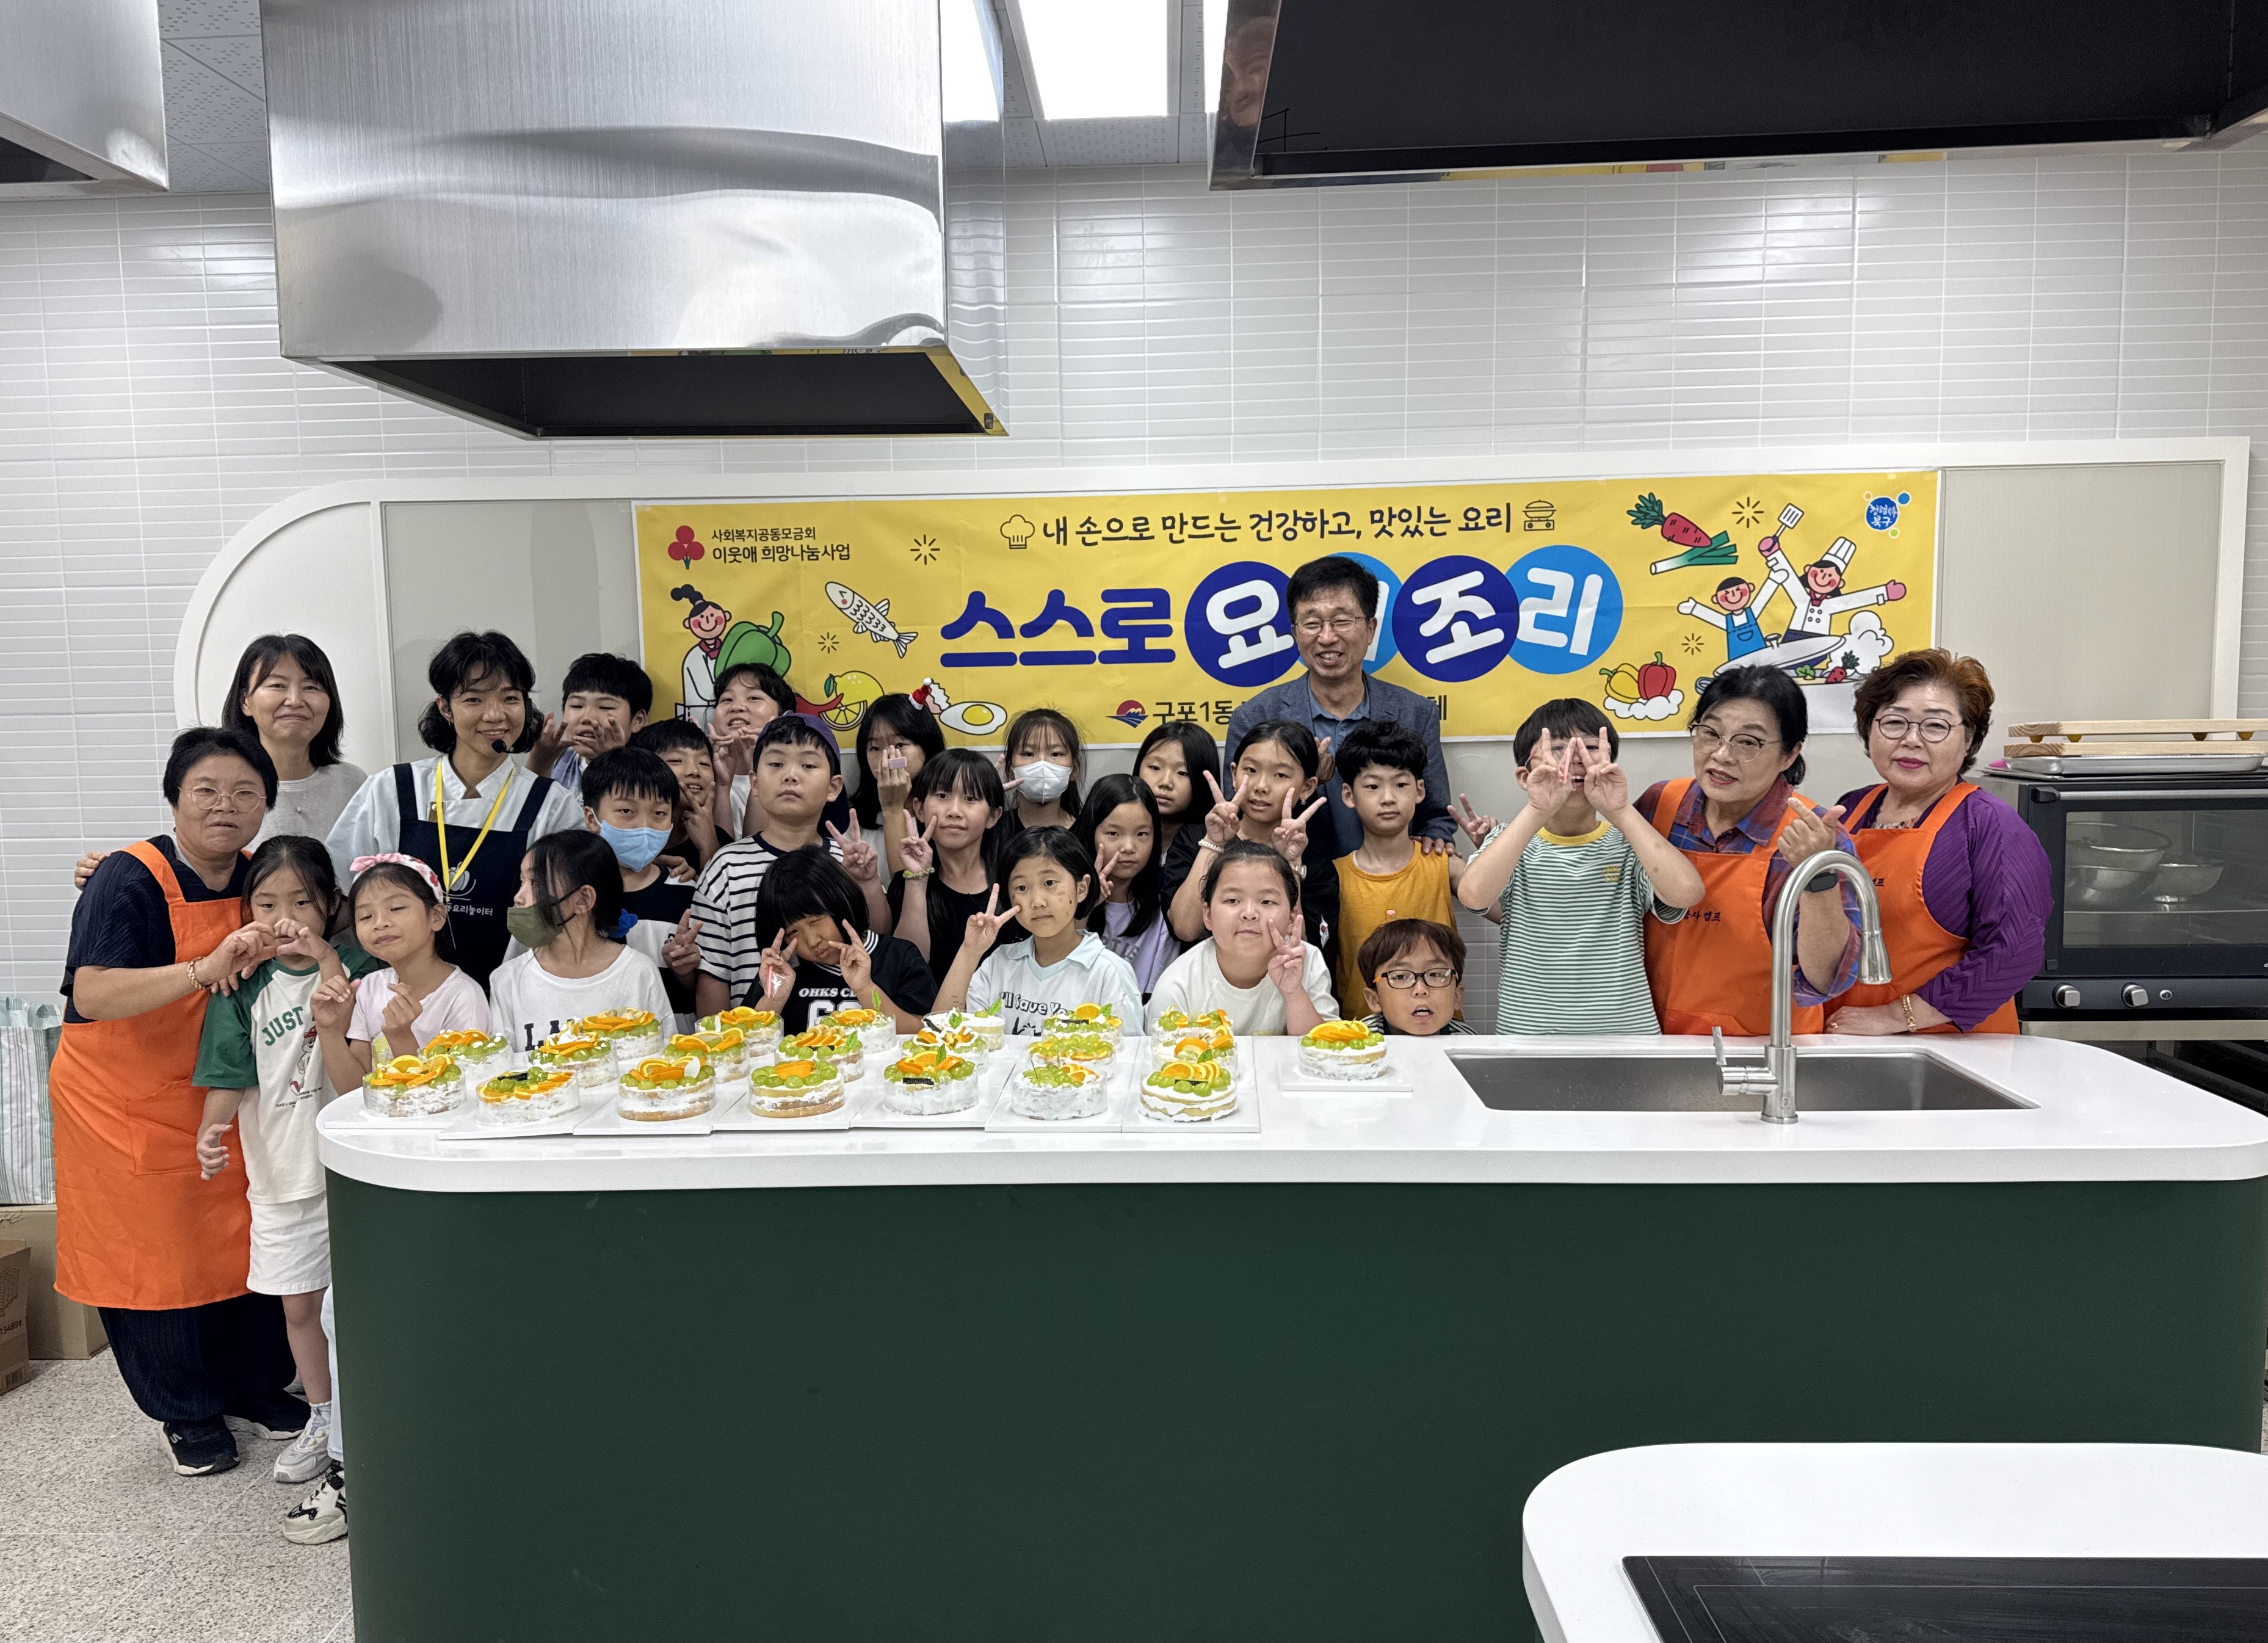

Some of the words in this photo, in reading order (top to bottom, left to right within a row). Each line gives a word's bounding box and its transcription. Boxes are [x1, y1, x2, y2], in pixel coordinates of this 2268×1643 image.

[711, 526, 817, 543] 사회복지공동모금회
[1043, 515, 1068, 546] 내
[1075, 515, 1155, 546] 손으로
[1161, 512, 1242, 544] 만드는
[1248, 509, 1362, 542] 건강하고,
[1369, 505, 1452, 539] 맛있는
[1457, 502, 1511, 533] 요리
[712, 545, 758, 564] 이웃애
[761, 543, 851, 562] 희망나눔사업
[940, 587, 1176, 668] 스스로
[1205, 566, 1604, 670] 요조리
[1152, 700, 1233, 725] 구포1동
[799, 987, 839, 998] OHKS
[261, 1006, 304, 1046] JUST
